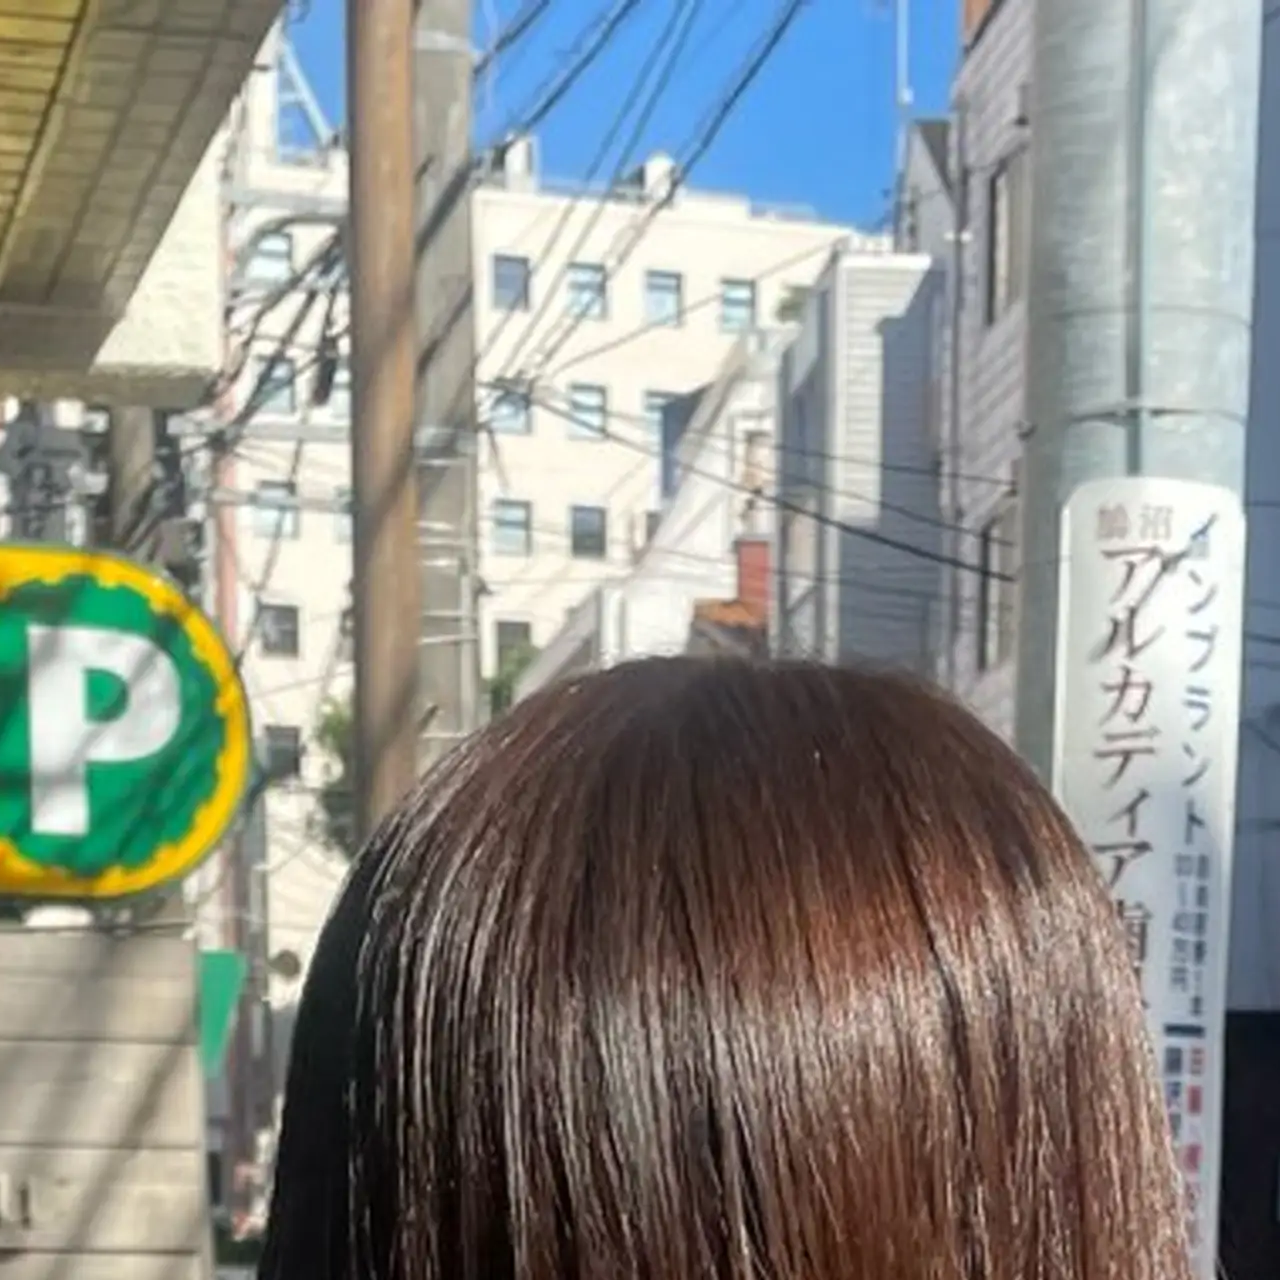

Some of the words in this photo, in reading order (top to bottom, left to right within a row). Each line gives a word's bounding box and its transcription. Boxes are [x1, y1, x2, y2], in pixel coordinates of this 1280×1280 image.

[28, 625, 182, 835] P
[1181, 512, 1219, 845] インプラント
